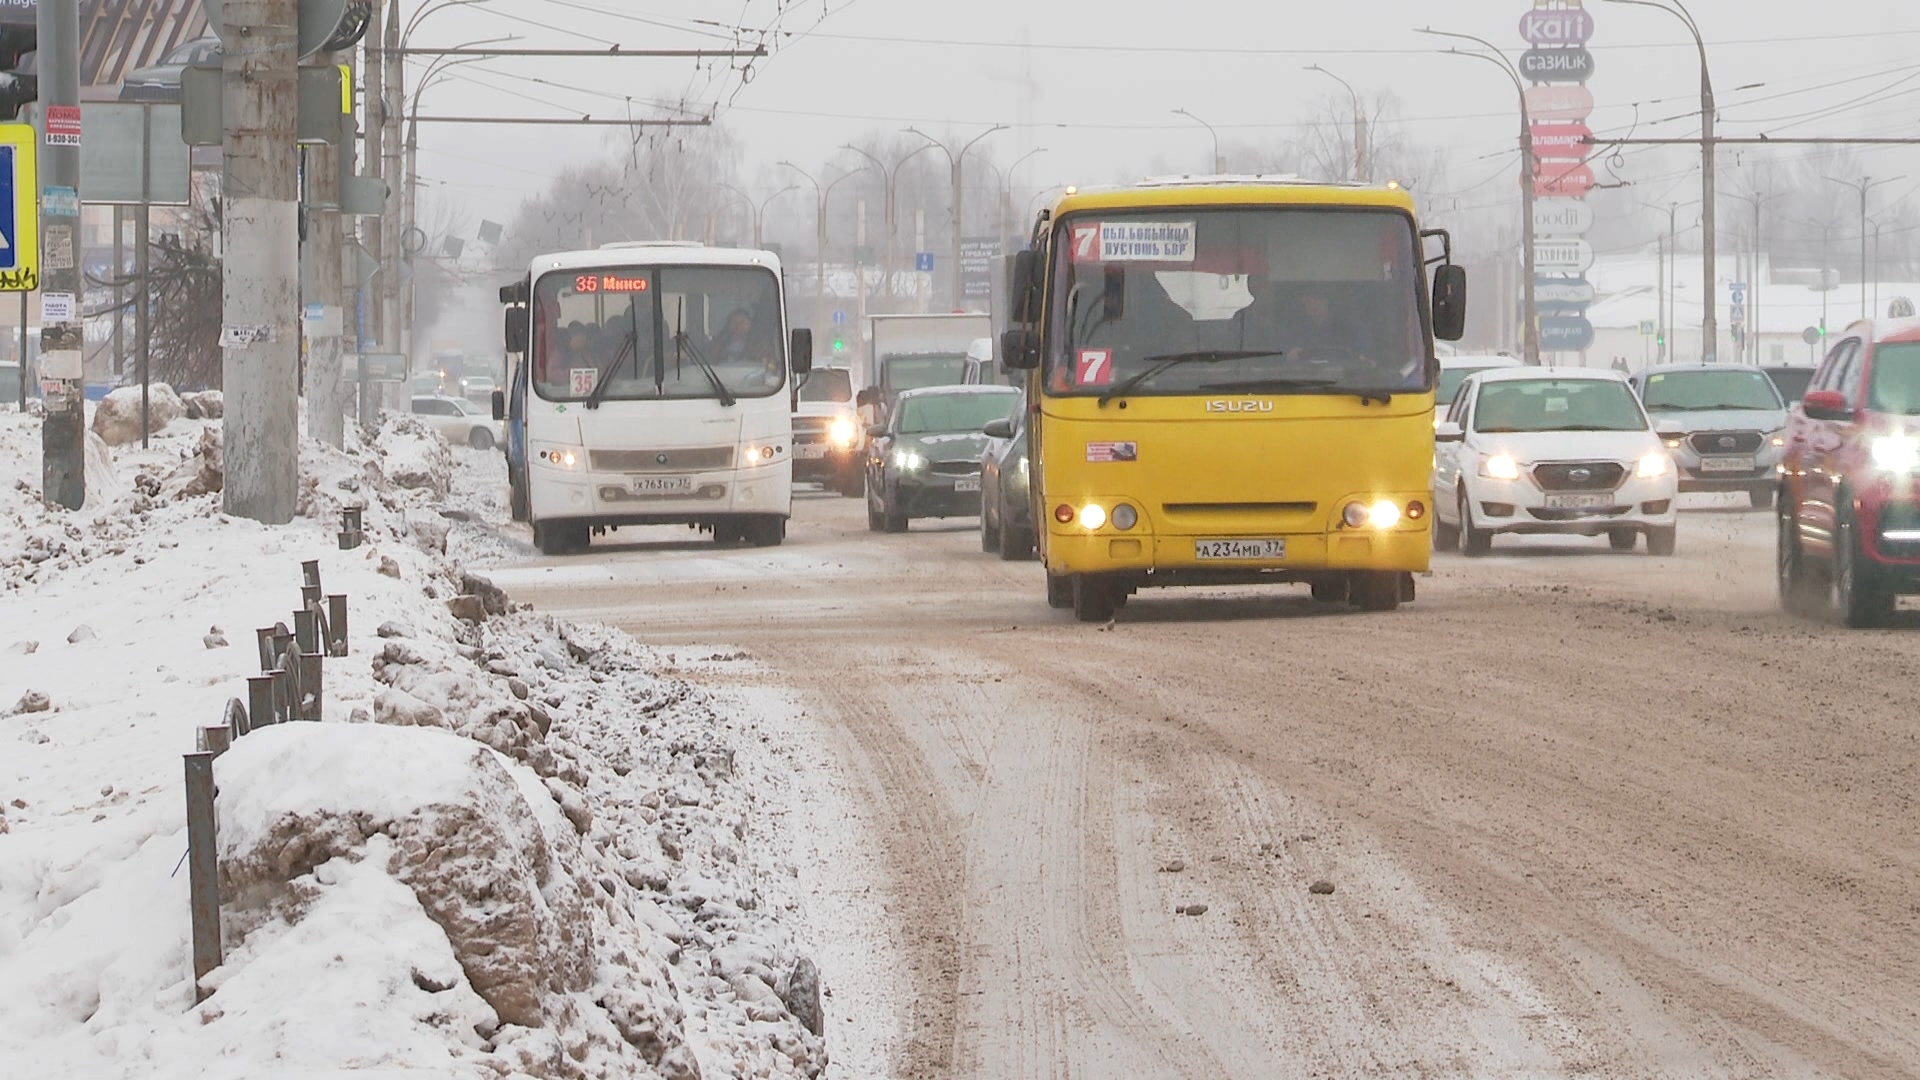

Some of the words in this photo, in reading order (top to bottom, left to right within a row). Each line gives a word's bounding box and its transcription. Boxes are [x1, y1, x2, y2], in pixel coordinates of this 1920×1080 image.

[1526, 15, 1584, 39] kari
[1075, 228, 1097, 257] 7
[1164, 242, 1188, 256] БОР
[576, 276, 598, 292] 35
[1082, 352, 1106, 382] 7
[575, 375, 592, 393] 35
[1206, 400, 1273, 412] ISUZU
